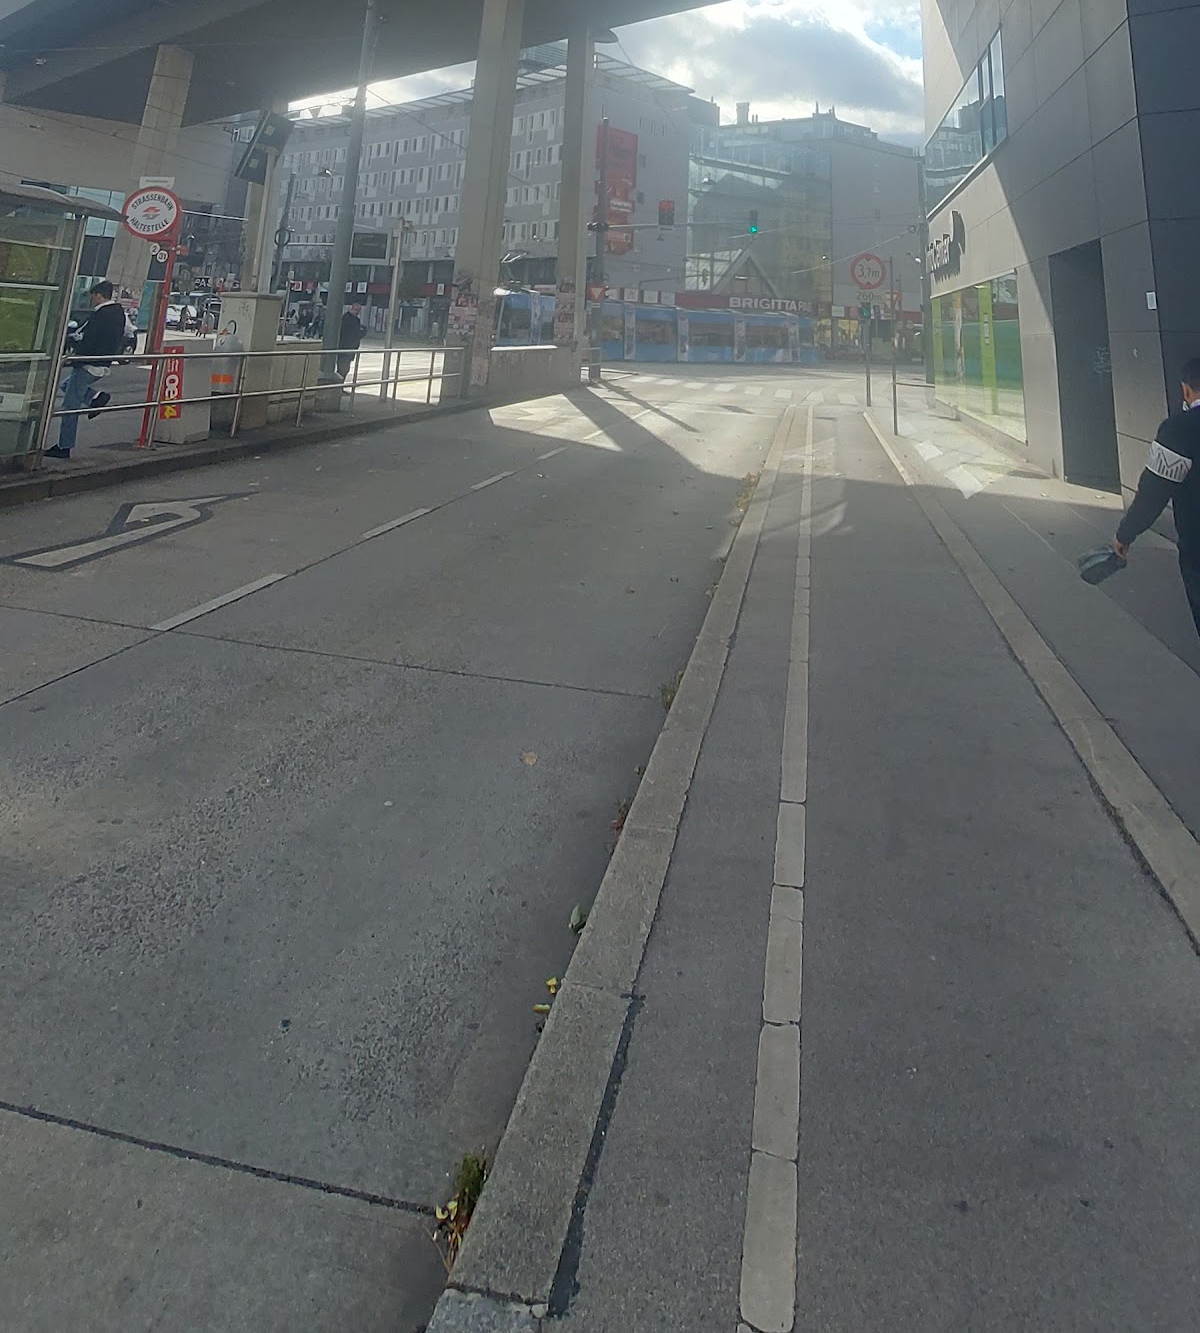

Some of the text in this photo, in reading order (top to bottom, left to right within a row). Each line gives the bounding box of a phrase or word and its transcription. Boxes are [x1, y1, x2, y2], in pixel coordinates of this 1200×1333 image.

[131, 194, 174, 211] STRASSENBAHN
[130, 217, 169, 232] HALTESTELLE
[858, 264, 881, 280] 3,7m
[856, 291, 883, 302] 260m
